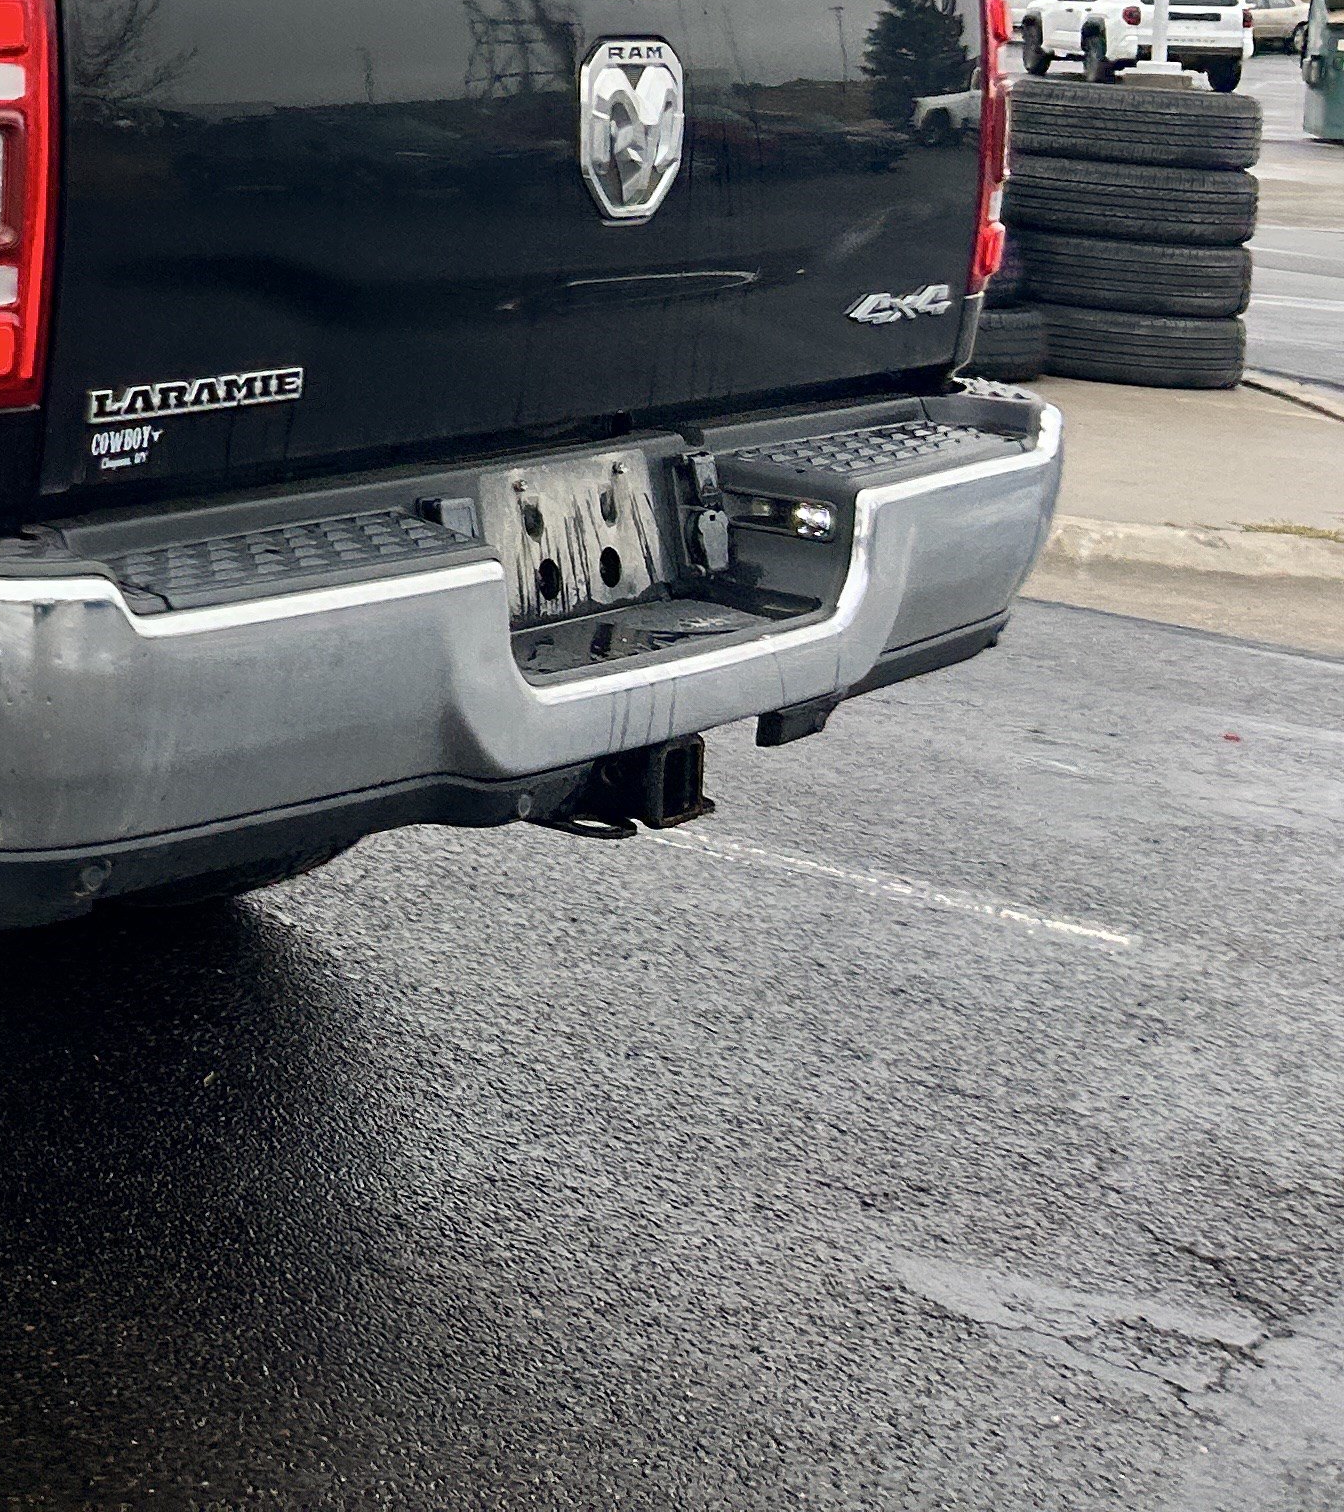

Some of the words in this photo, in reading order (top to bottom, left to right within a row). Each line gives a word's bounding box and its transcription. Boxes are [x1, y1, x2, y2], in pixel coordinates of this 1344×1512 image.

[608, 46, 663, 60] RAM
[88, 368, 304, 424] LARAMIE
[91, 425, 152, 456] COWBOY
